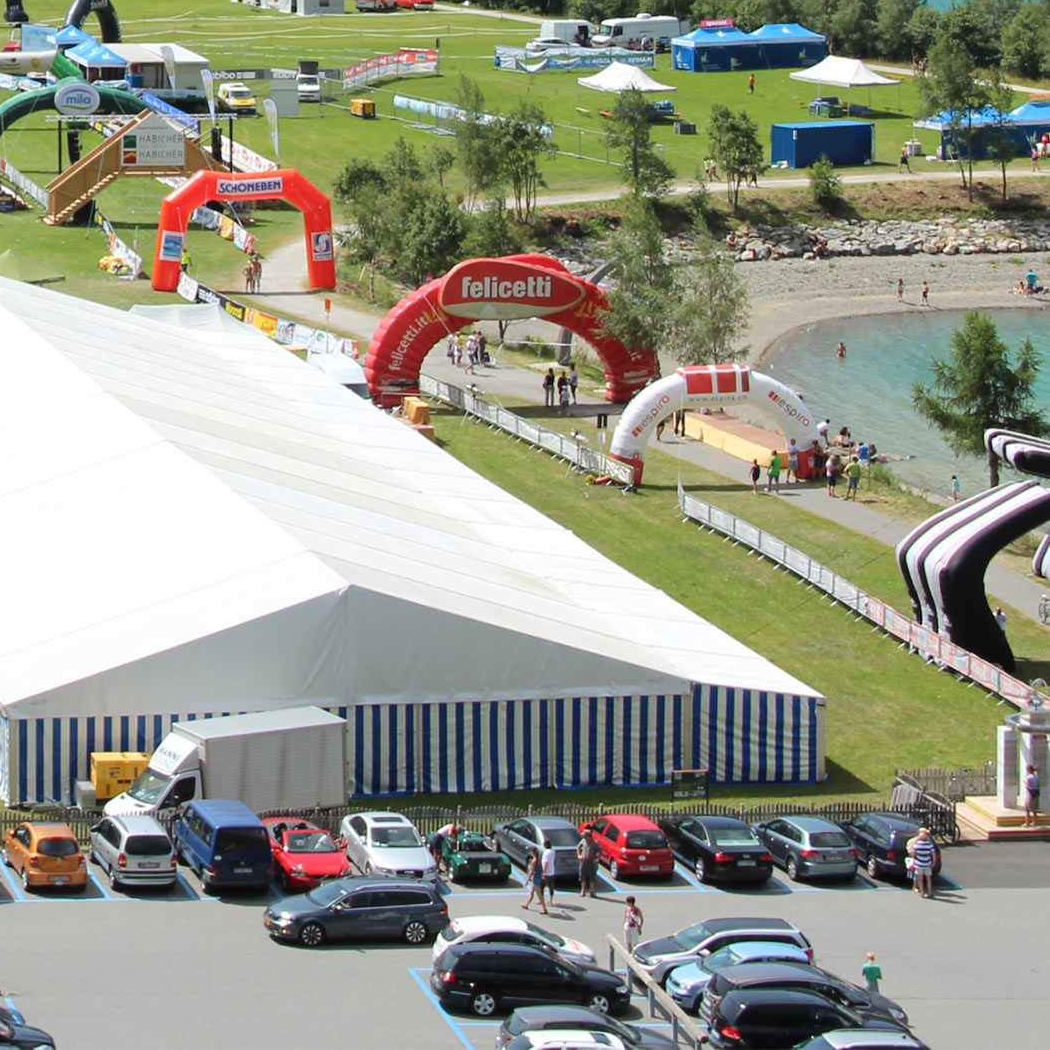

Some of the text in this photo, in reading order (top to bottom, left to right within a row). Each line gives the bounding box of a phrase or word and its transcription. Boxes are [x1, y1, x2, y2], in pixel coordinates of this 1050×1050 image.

[66, 93, 91, 104] mila
[139, 135, 183, 143] HABICHER
[139, 150, 183, 158] HABICHER
[461, 276, 552, 299] felicetti
[388, 315, 429, 371] felicetti.it
